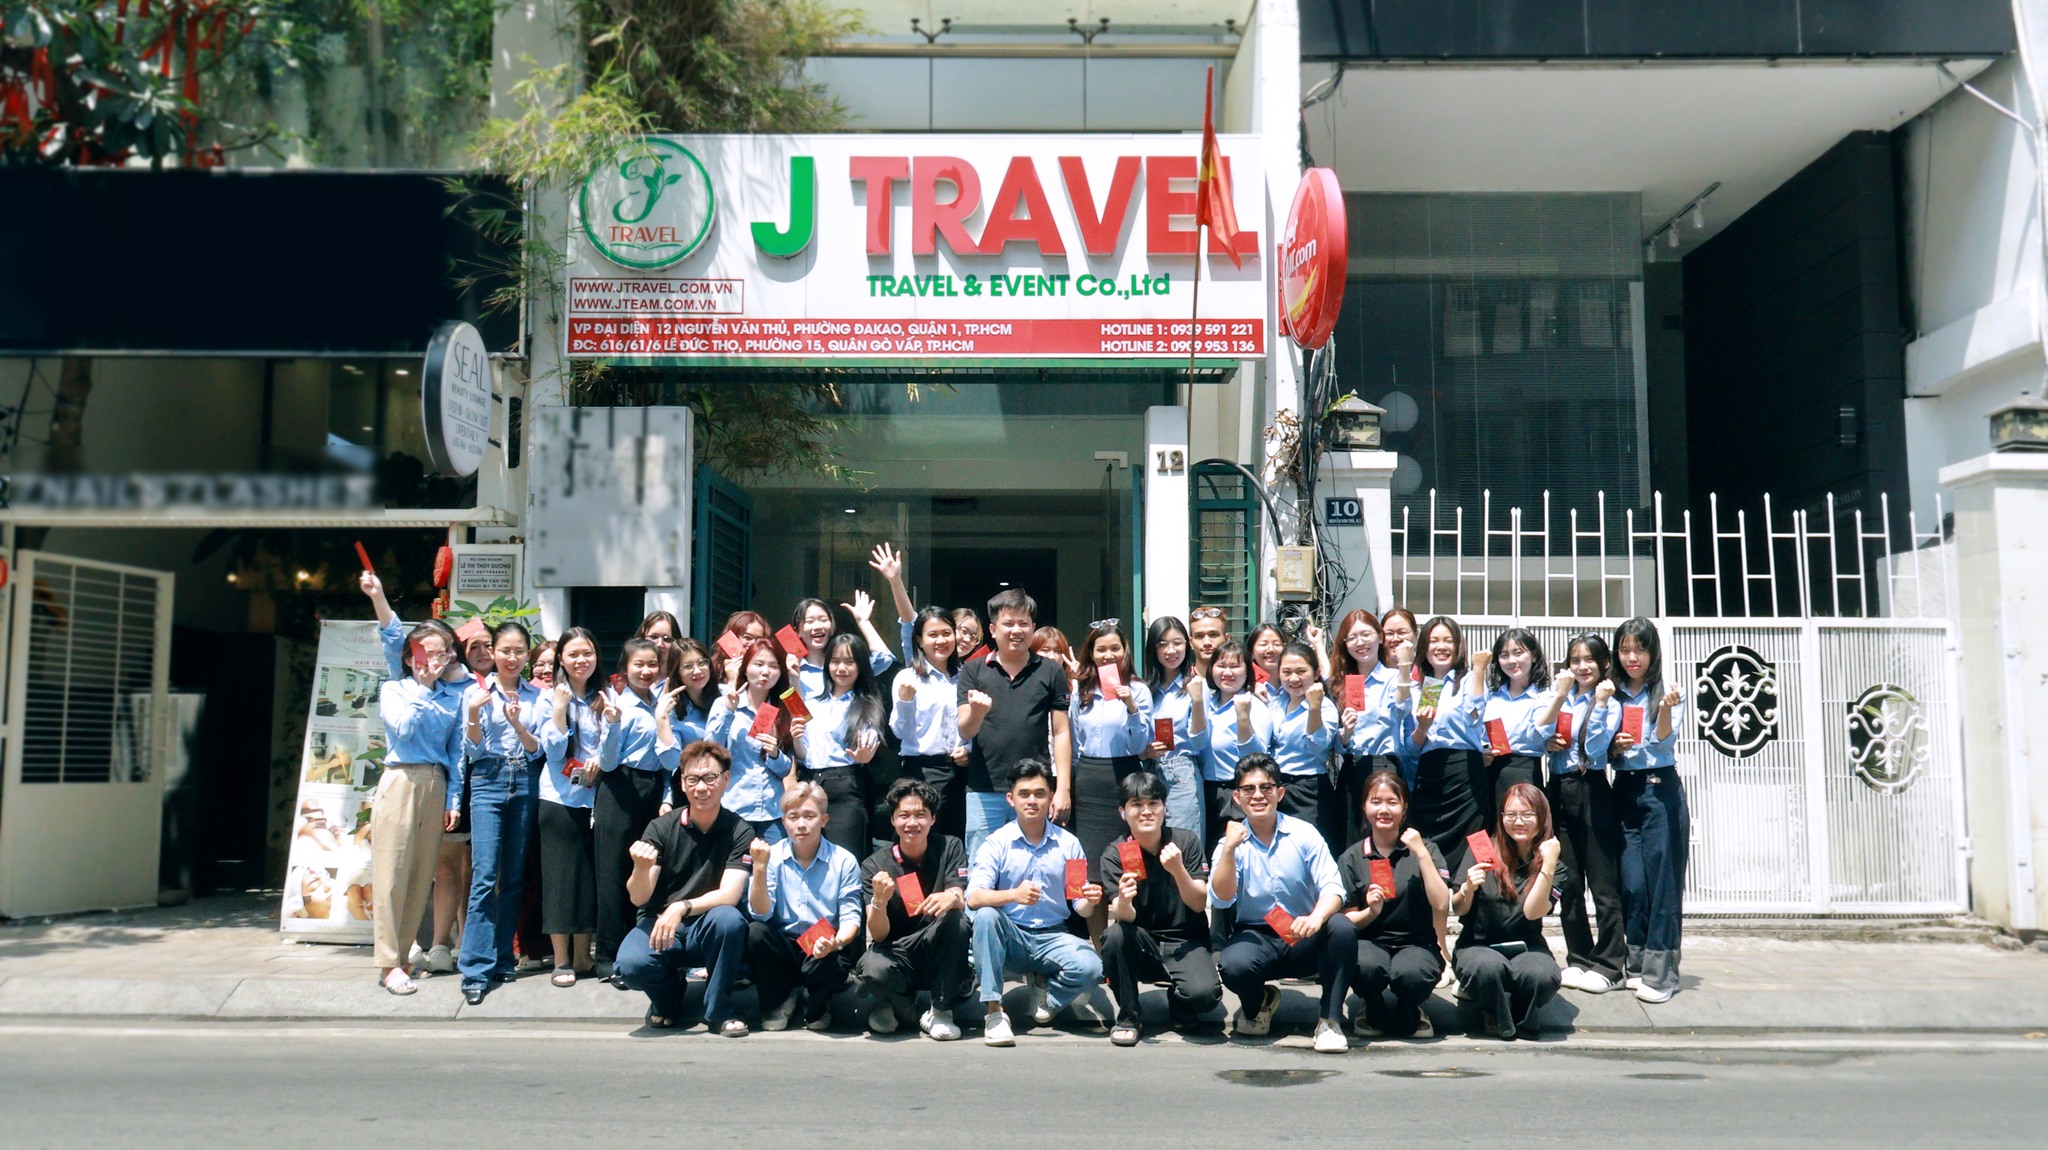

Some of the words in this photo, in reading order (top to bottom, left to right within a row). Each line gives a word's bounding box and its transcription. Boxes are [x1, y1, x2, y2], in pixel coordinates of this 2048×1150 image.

[750, 156, 815, 258] J
[850, 156, 1259, 257] TRAVEL
[609, 226, 683, 243] TRAVEL
[574, 282, 733, 295] WWW.JTRAVEL.COM.VN
[866, 274, 958, 297] TRAVEL
[963, 273, 983, 297] &
[990, 274, 1070, 297] EVENT
[1075, 273, 1171, 301] Co.,Ltd
[574, 298, 717, 311] WWW.JTEAM.COM.VN
[573, 323, 592, 335] VP
[594, 323, 617, 338] ĐẠI
[620, 321, 650, 338] DIỆN
[657, 323, 672, 335] 12
[674, 319, 728, 335] NGUYỄN
[731, 321, 760, 335] VĂN
[793, 321, 851, 336] PHƯỜNG
[854, 323, 905, 337] ĐAKAO,
[908, 320, 948, 338] QUẬN
[951, 323, 962, 337] 1,
[964, 323, 1013, 336] TP.HCM
[1101, 324, 1153, 336] HOTLINE
[1156, 324, 1168, 336] 1:
[1204, 324, 1227, 336] 591
[1231, 324, 1254, 336] 221
[573, 339, 597, 351] ĐC:
[600, 339, 662, 352] 616/61/6
[664, 337, 677, 351] LÊ
[680, 337, 709, 351] ĐỨC
[712, 339, 742, 354] THỌ,
[745, 337, 803, 352] PHƯỜNG
[807, 339, 825, 353] 15,
[870, 337, 892, 352] GÒ
[895, 335, 924, 353] VẤP,
[926, 339, 975, 352] TP.HCM
[1101, 341, 1153, 353] HOTLINE
[1156, 341, 1168, 353] 2:
[1204, 341, 1229, 353] 953
[1232, 341, 1256, 353] 136
[453, 341, 487, 393] SEAL
[1156, 450, 1185, 472] 12
[1331, 500, 1359, 517] 10
